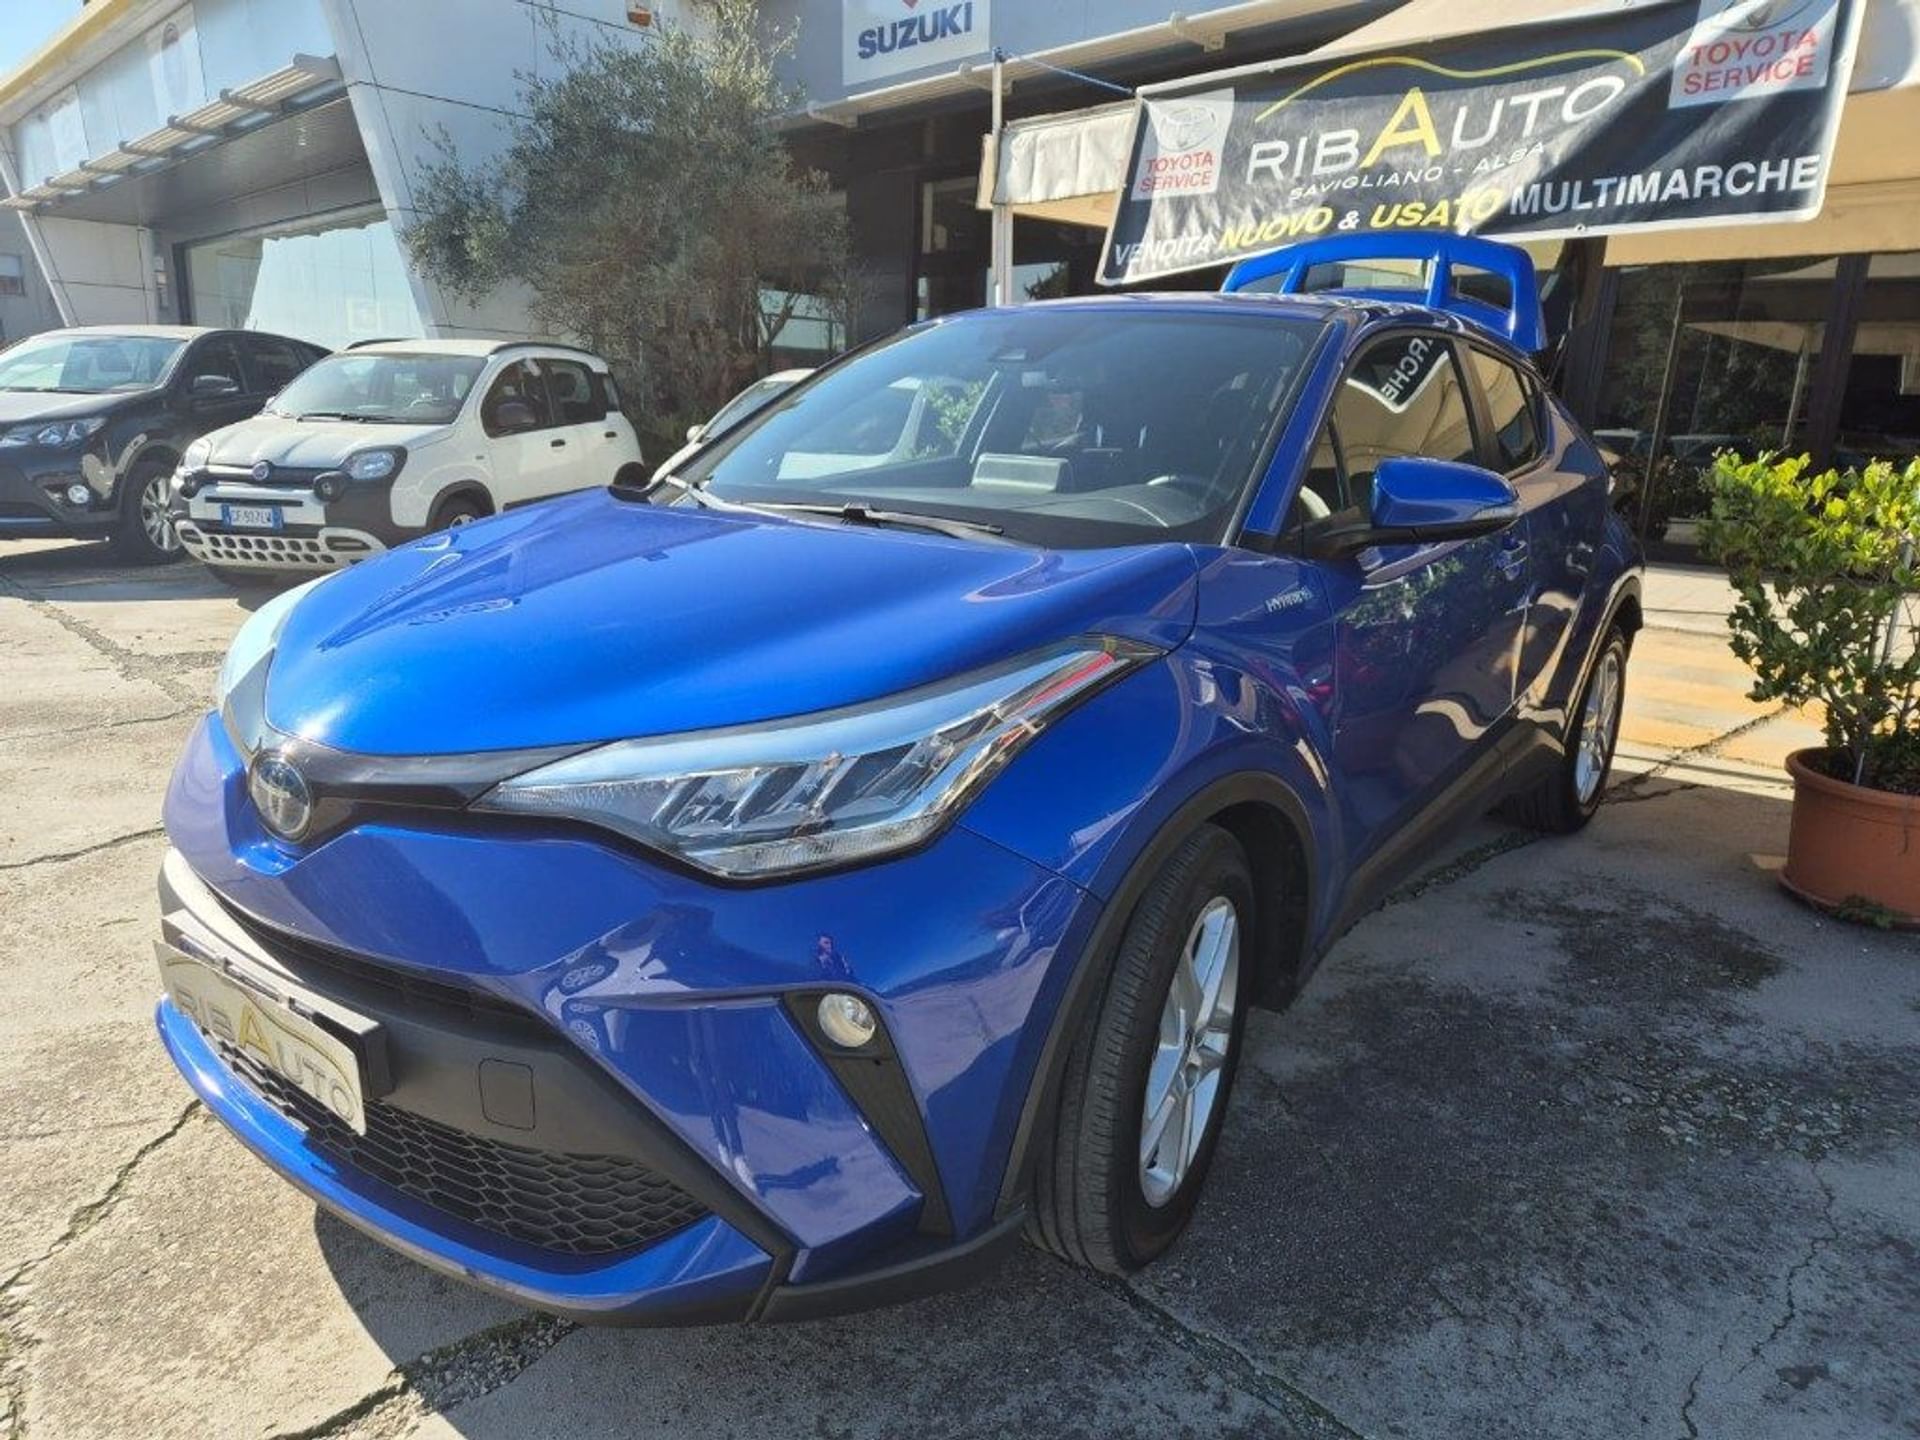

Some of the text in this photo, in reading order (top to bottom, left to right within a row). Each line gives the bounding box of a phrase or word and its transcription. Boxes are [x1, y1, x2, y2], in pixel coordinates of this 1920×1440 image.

[857, 2, 973, 59] SUZUKI
[1690, 28, 1819, 67] TOYOTA
[1683, 54, 1817, 95] SERVICE
[1139, 171, 1212, 193] SERVICE
[1145, 151, 1214, 172] TOYOTA
[1288, 166, 1443, 202] SAVIGLIANO
[1472, 141, 1544, 175] ALBA
[1115, 153, 1821, 266] VENDITA NUOVO & USATO MULTIMARCHE
